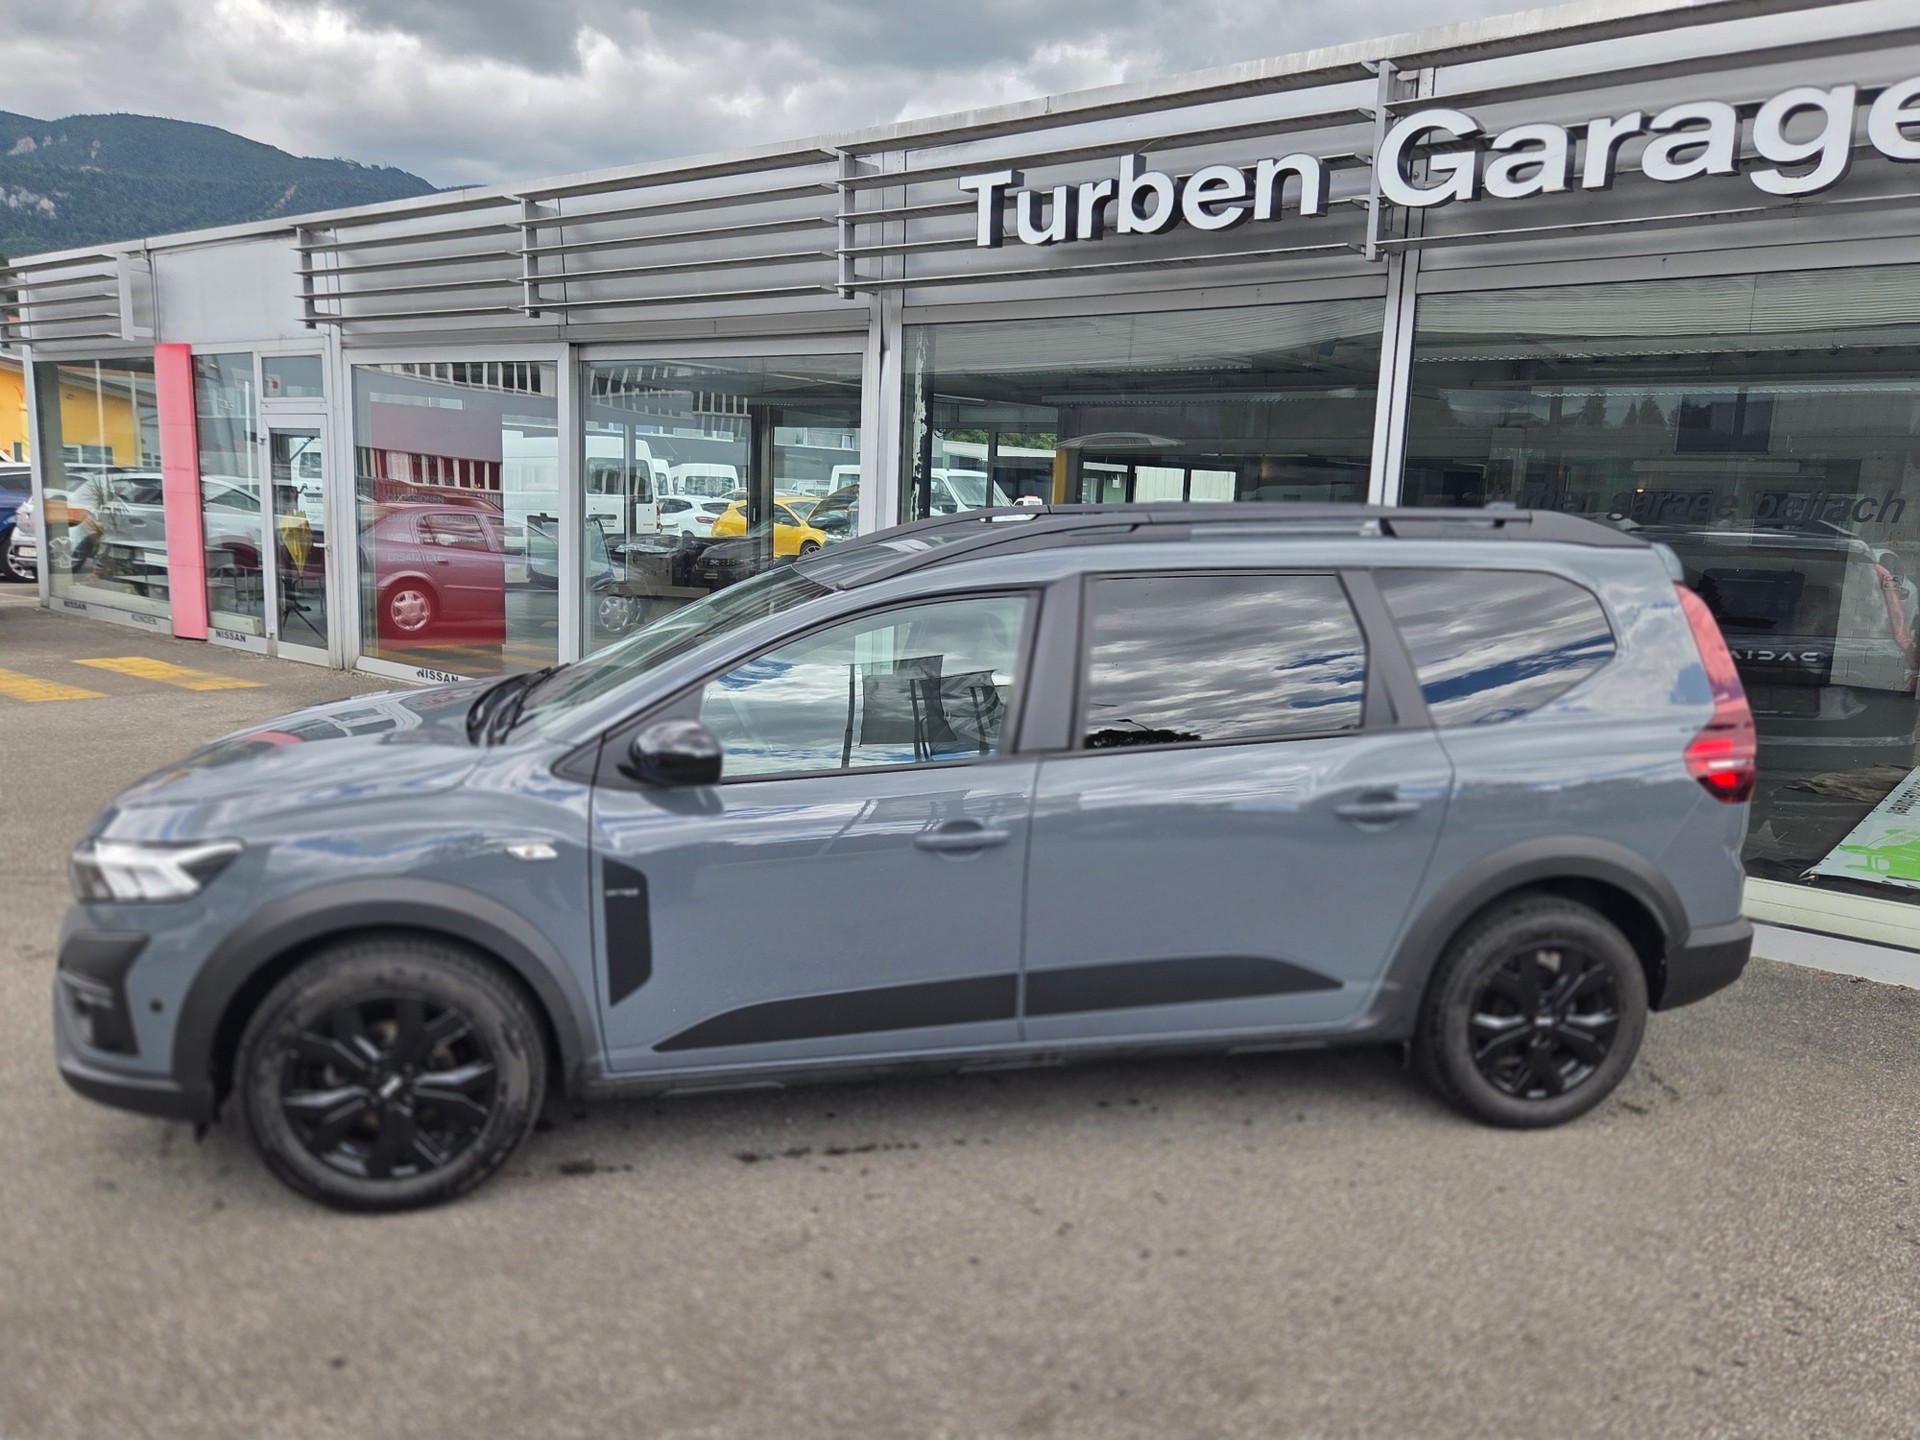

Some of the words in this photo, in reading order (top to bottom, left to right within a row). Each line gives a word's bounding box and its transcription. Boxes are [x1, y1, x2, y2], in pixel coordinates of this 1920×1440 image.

[959, 152, 1322, 247] Turben
[1756, 490, 1905, 523] bellach
[216, 630, 246, 643] NISSAN
[416, 669, 459, 683] NISSAN
